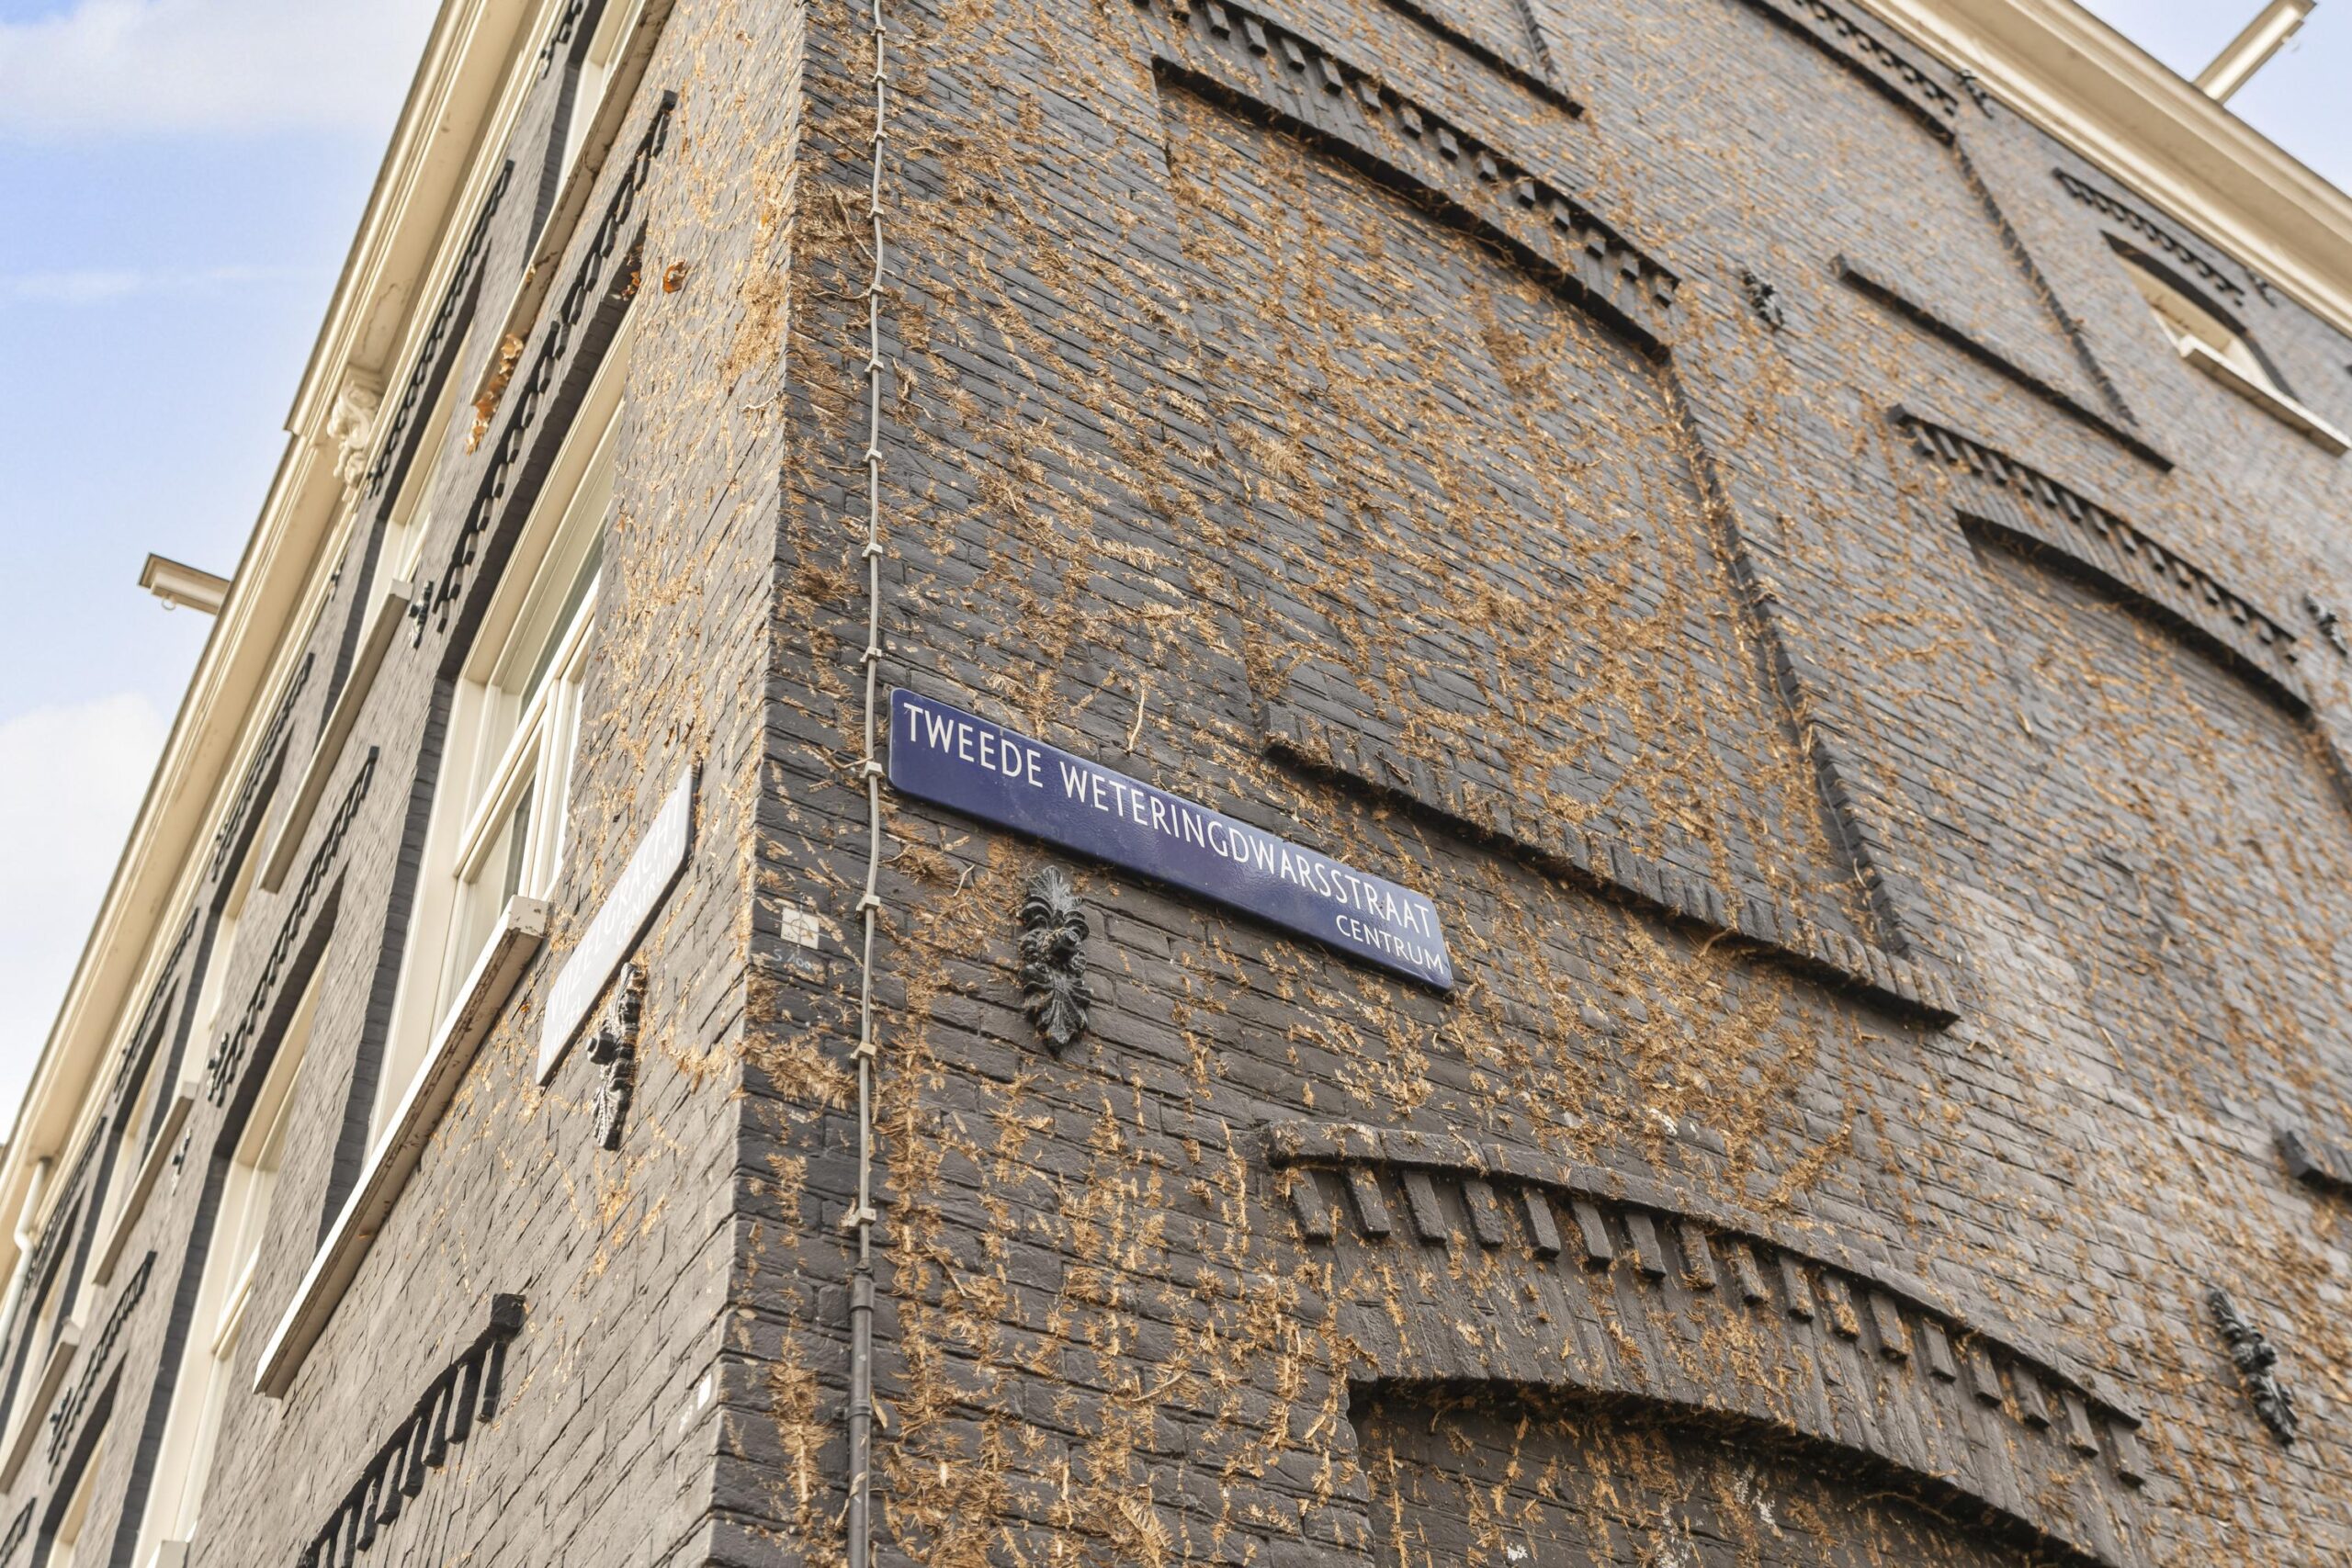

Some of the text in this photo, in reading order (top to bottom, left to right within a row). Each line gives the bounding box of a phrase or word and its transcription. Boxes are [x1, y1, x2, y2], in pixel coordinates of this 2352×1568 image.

[551, 786, 682, 1021] VIJZELGRACHT
[616, 834, 678, 945] CENTRUM
[902, 704, 1432, 938] TWEEDE WETERINGDWARSSTRAAT
[1336, 914, 1443, 975] CENTRUM
